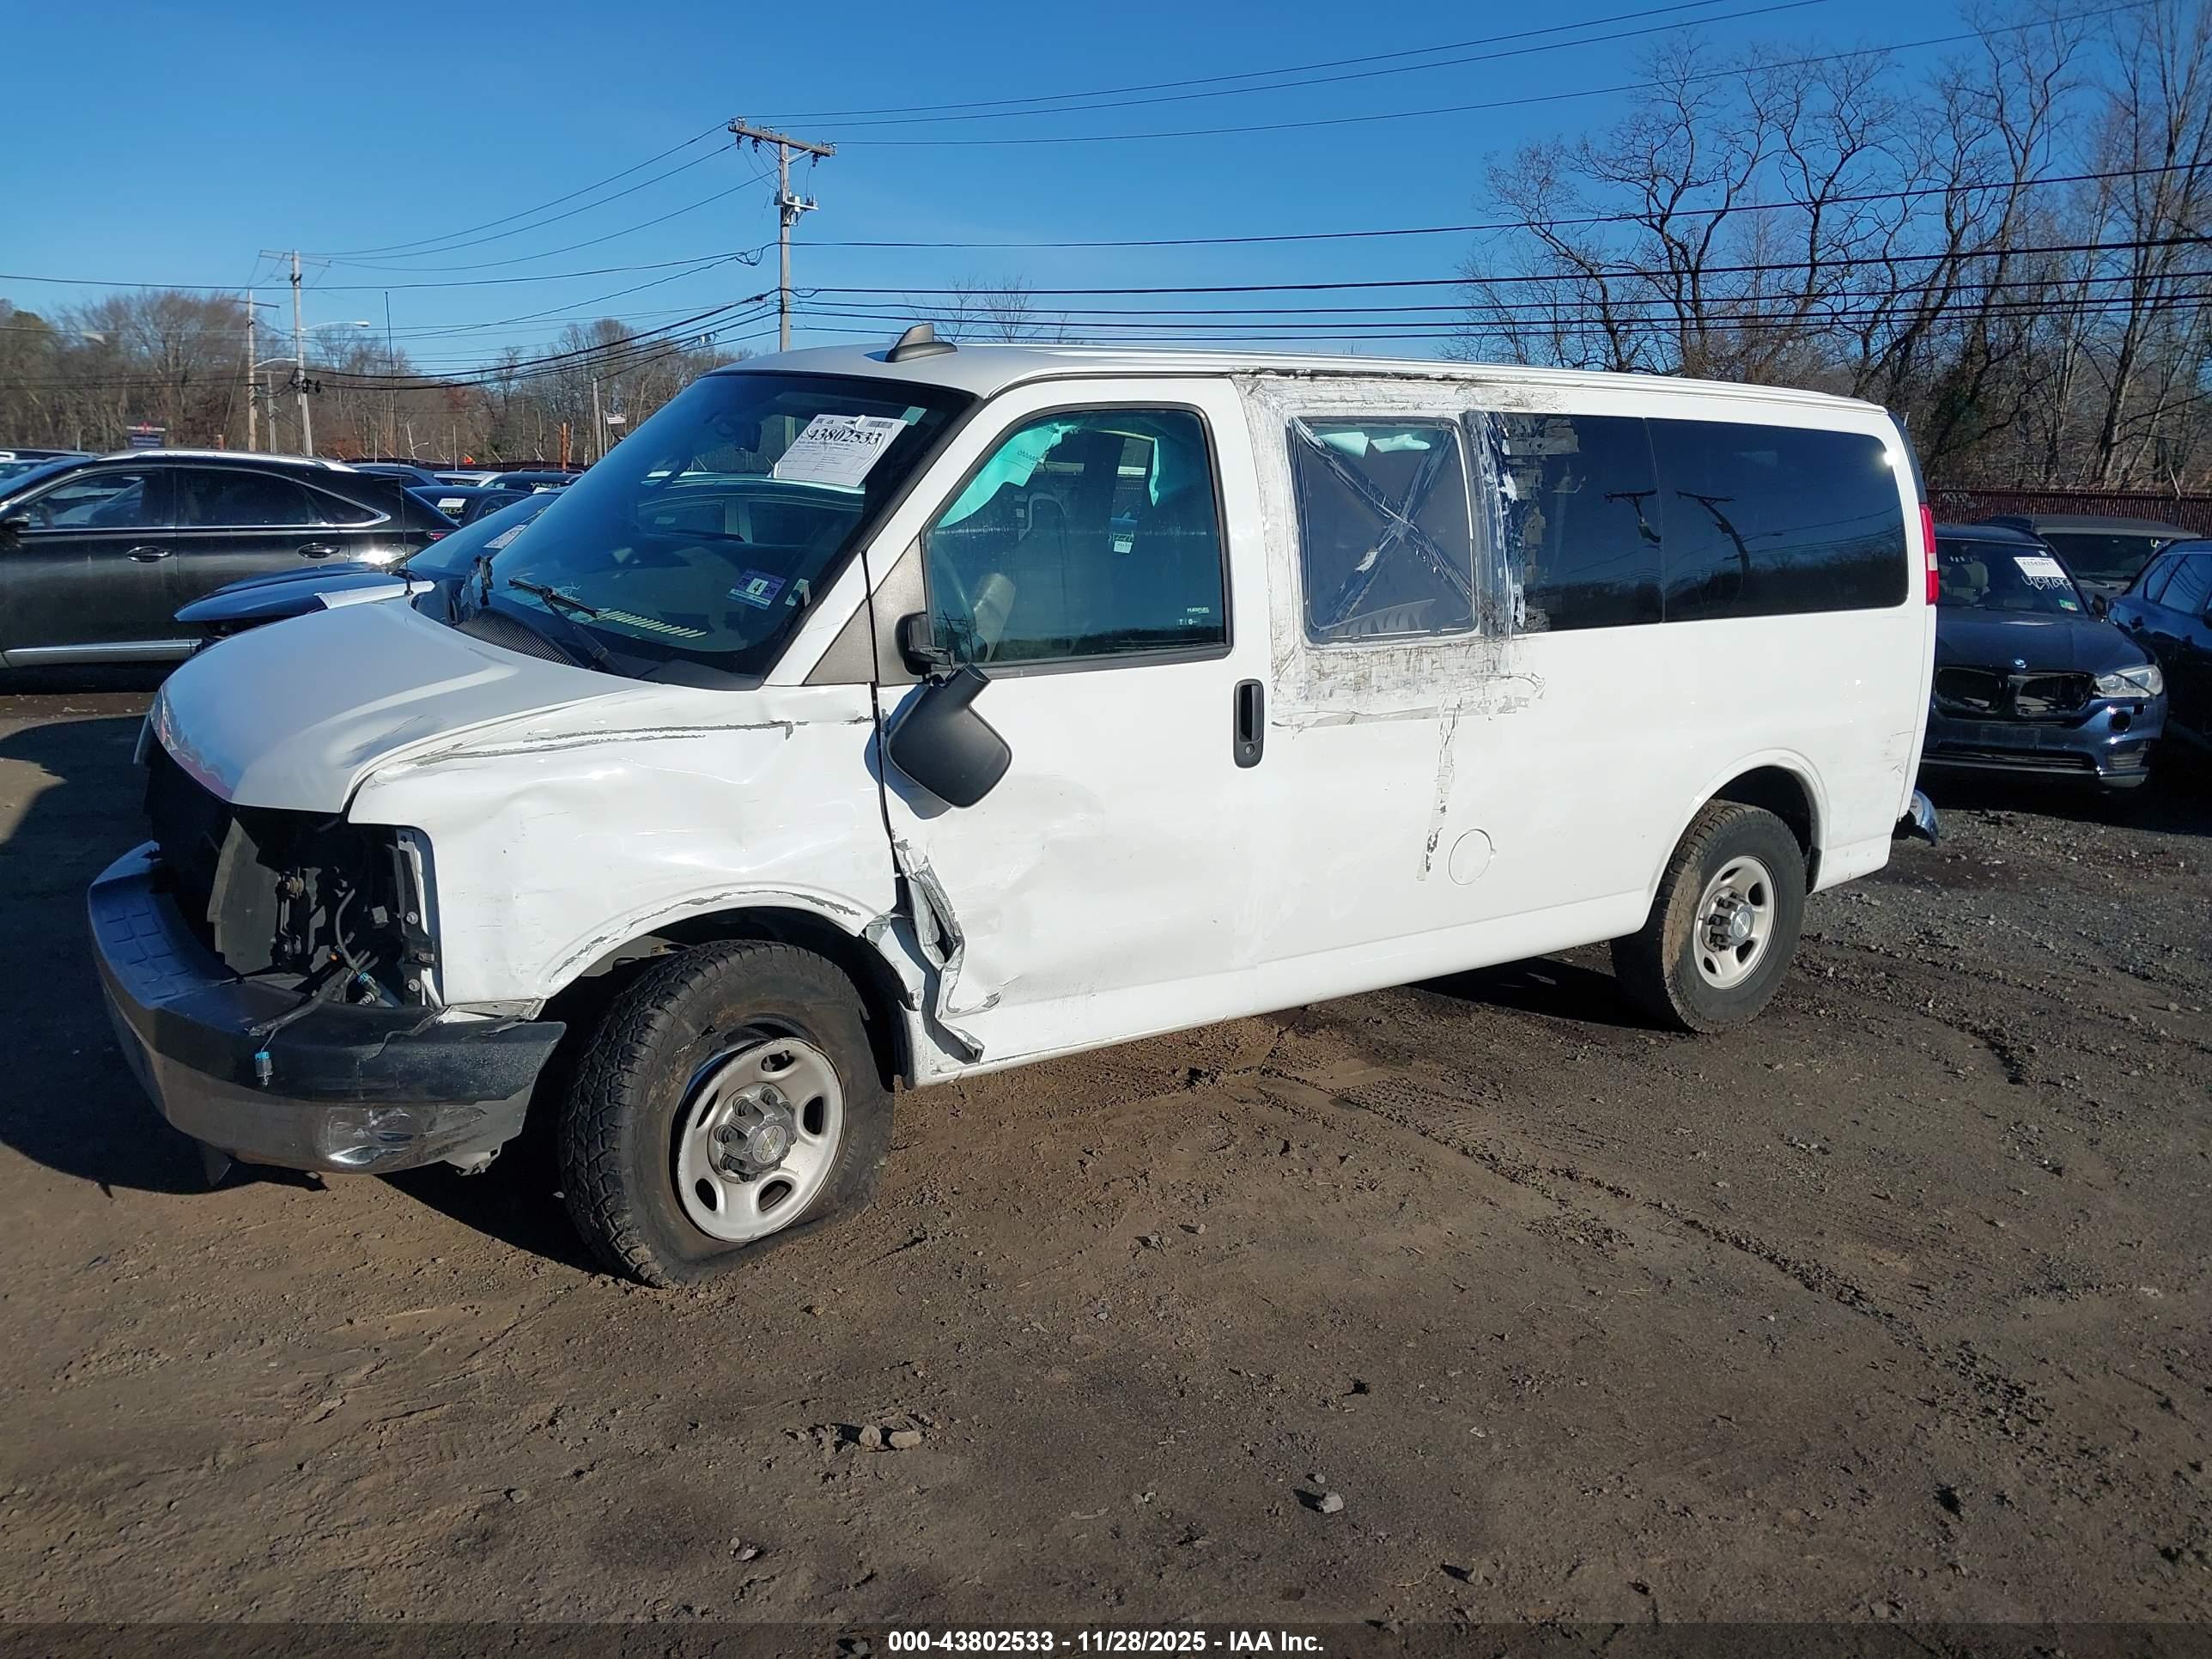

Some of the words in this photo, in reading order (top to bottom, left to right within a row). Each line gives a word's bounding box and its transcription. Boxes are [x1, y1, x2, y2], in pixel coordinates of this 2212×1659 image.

[806, 428, 883, 445] 43802533
[753, 581, 763, 593] 4
[765, 586, 776, 595] 26
